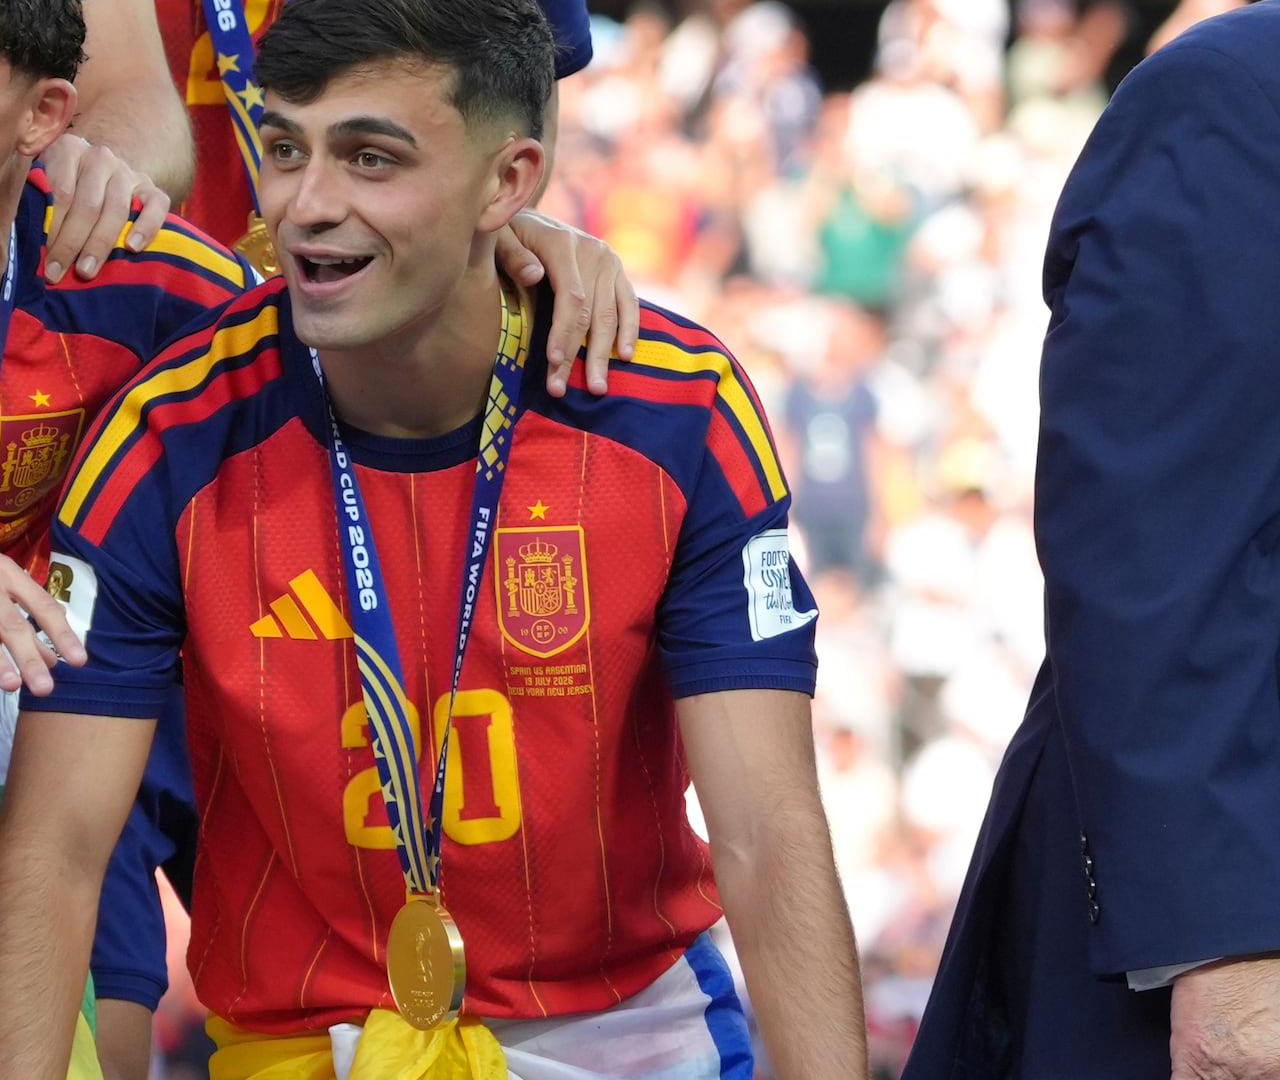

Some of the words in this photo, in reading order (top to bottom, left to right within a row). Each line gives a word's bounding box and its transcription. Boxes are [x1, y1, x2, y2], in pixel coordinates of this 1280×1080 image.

[328, 404, 347, 469] RLD
[340, 472, 360, 522] CUP
[472, 506, 491, 558] FIFA
[348, 525, 377, 611] 2026
[761, 550, 789, 567] FOOTB
[456, 562, 480, 651] WORLD
[508, 686, 524, 696] NEW
[525, 686, 546, 696] YORK
[547, 686, 565, 696] NEW
[567, 684, 594, 696] JERSEY
[524, 677, 533, 686] 19
[535, 676, 551, 686] JULY
[552, 675, 574, 686] 2026
[340, 687, 522, 850] 20
